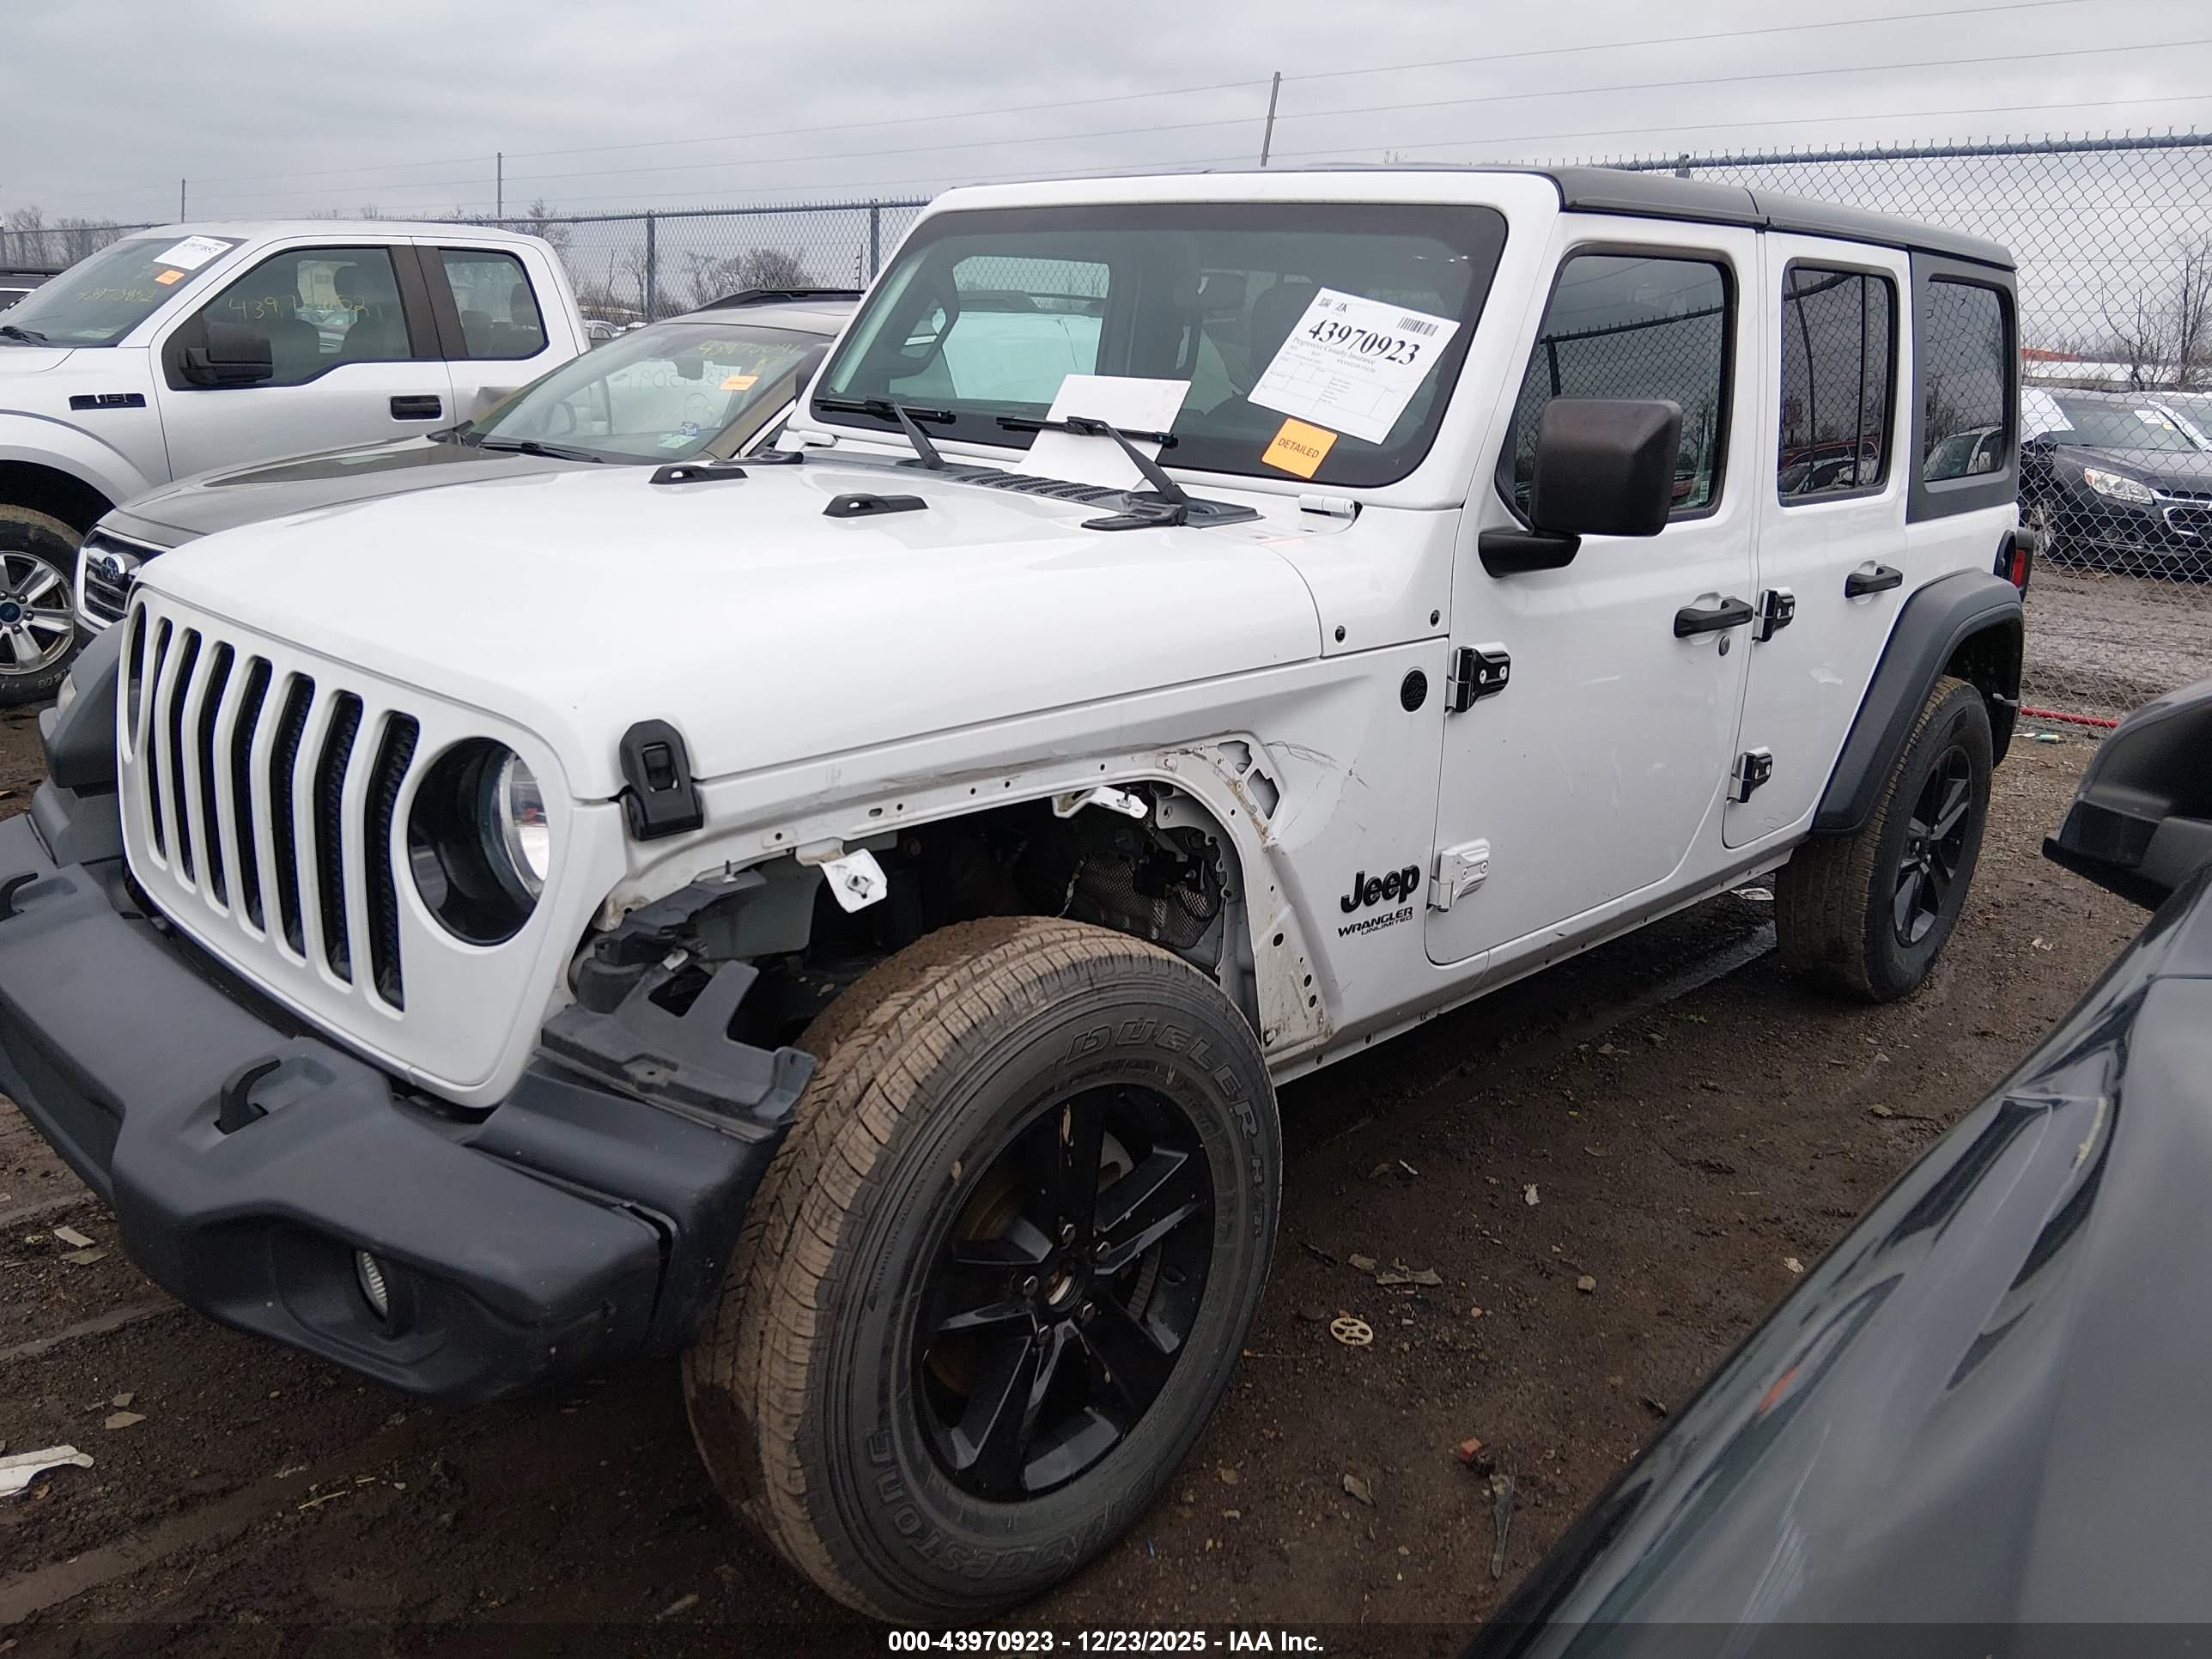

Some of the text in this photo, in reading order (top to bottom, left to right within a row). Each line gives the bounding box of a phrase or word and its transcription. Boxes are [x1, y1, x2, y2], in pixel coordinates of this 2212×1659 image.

[1308, 319, 1421, 366] 43970923
[1278, 437, 1321, 459] DETAILED
[1340, 864, 1420, 913] Jeep
[1338, 907, 1414, 937] WRANGLER
[1361, 915, 1413, 935] UNLIMITED
[1063, 1018, 1259, 1139] DUELER
